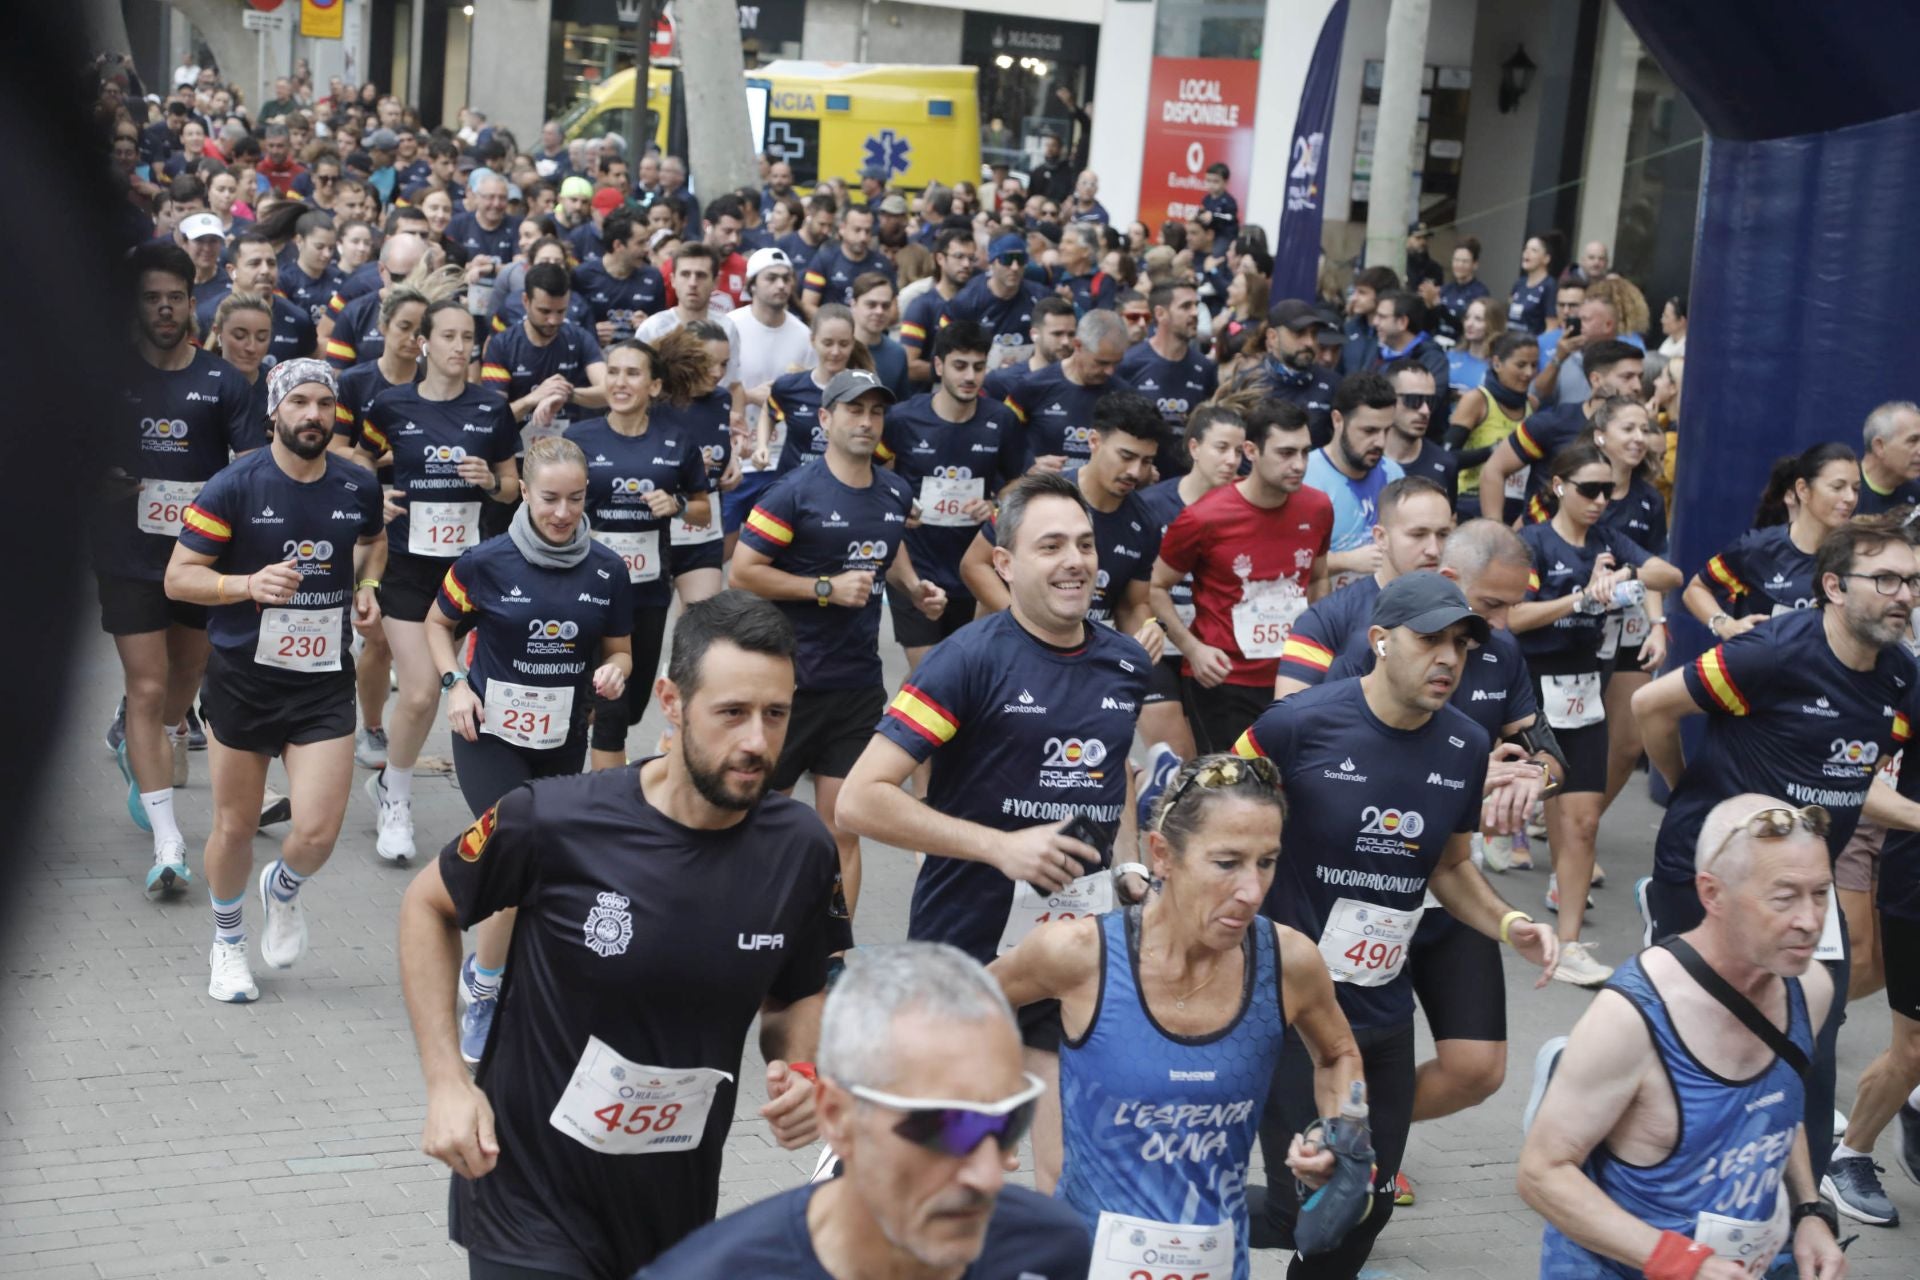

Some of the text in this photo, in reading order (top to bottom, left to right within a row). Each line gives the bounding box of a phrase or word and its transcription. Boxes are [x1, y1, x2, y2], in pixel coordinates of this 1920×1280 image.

[1179, 79, 1222, 102] LOCAL
[771, 92, 816, 112] NCIA
[1163, 101, 1240, 127] DISPONIBLE
[141, 418, 188, 438] 200
[424, 445, 466, 463] 200
[612, 477, 655, 494] 200
[934, 499, 959, 515] 46
[251, 516, 284, 524] Santander
[427, 524, 466, 544] 122
[282, 540, 334, 561] 200
[847, 540, 888, 559] 200
[501, 595, 532, 603] Santander
[528, 619, 579, 640] 200
[278, 636, 327, 658] 230
[1003, 703, 1047, 714] Santander
[1566, 697, 1584, 717] 76
[502, 709, 551, 735] 231
[1042, 737, 1107, 767] 200
[1827, 738, 1879, 765] 200
[1039, 779, 1104, 788] NACIONAL
[1040, 770, 1089, 779] POLICIA
[1324, 769, 1368, 783] Santander
[1359, 806, 1425, 838] 200
[1355, 845, 1417, 858] NACIONAL
[1357, 836, 1406, 848] POLICIA
[738, 933, 785, 950] UPA
[1344, 939, 1402, 970] 490
[594, 1103, 683, 1135] 458
